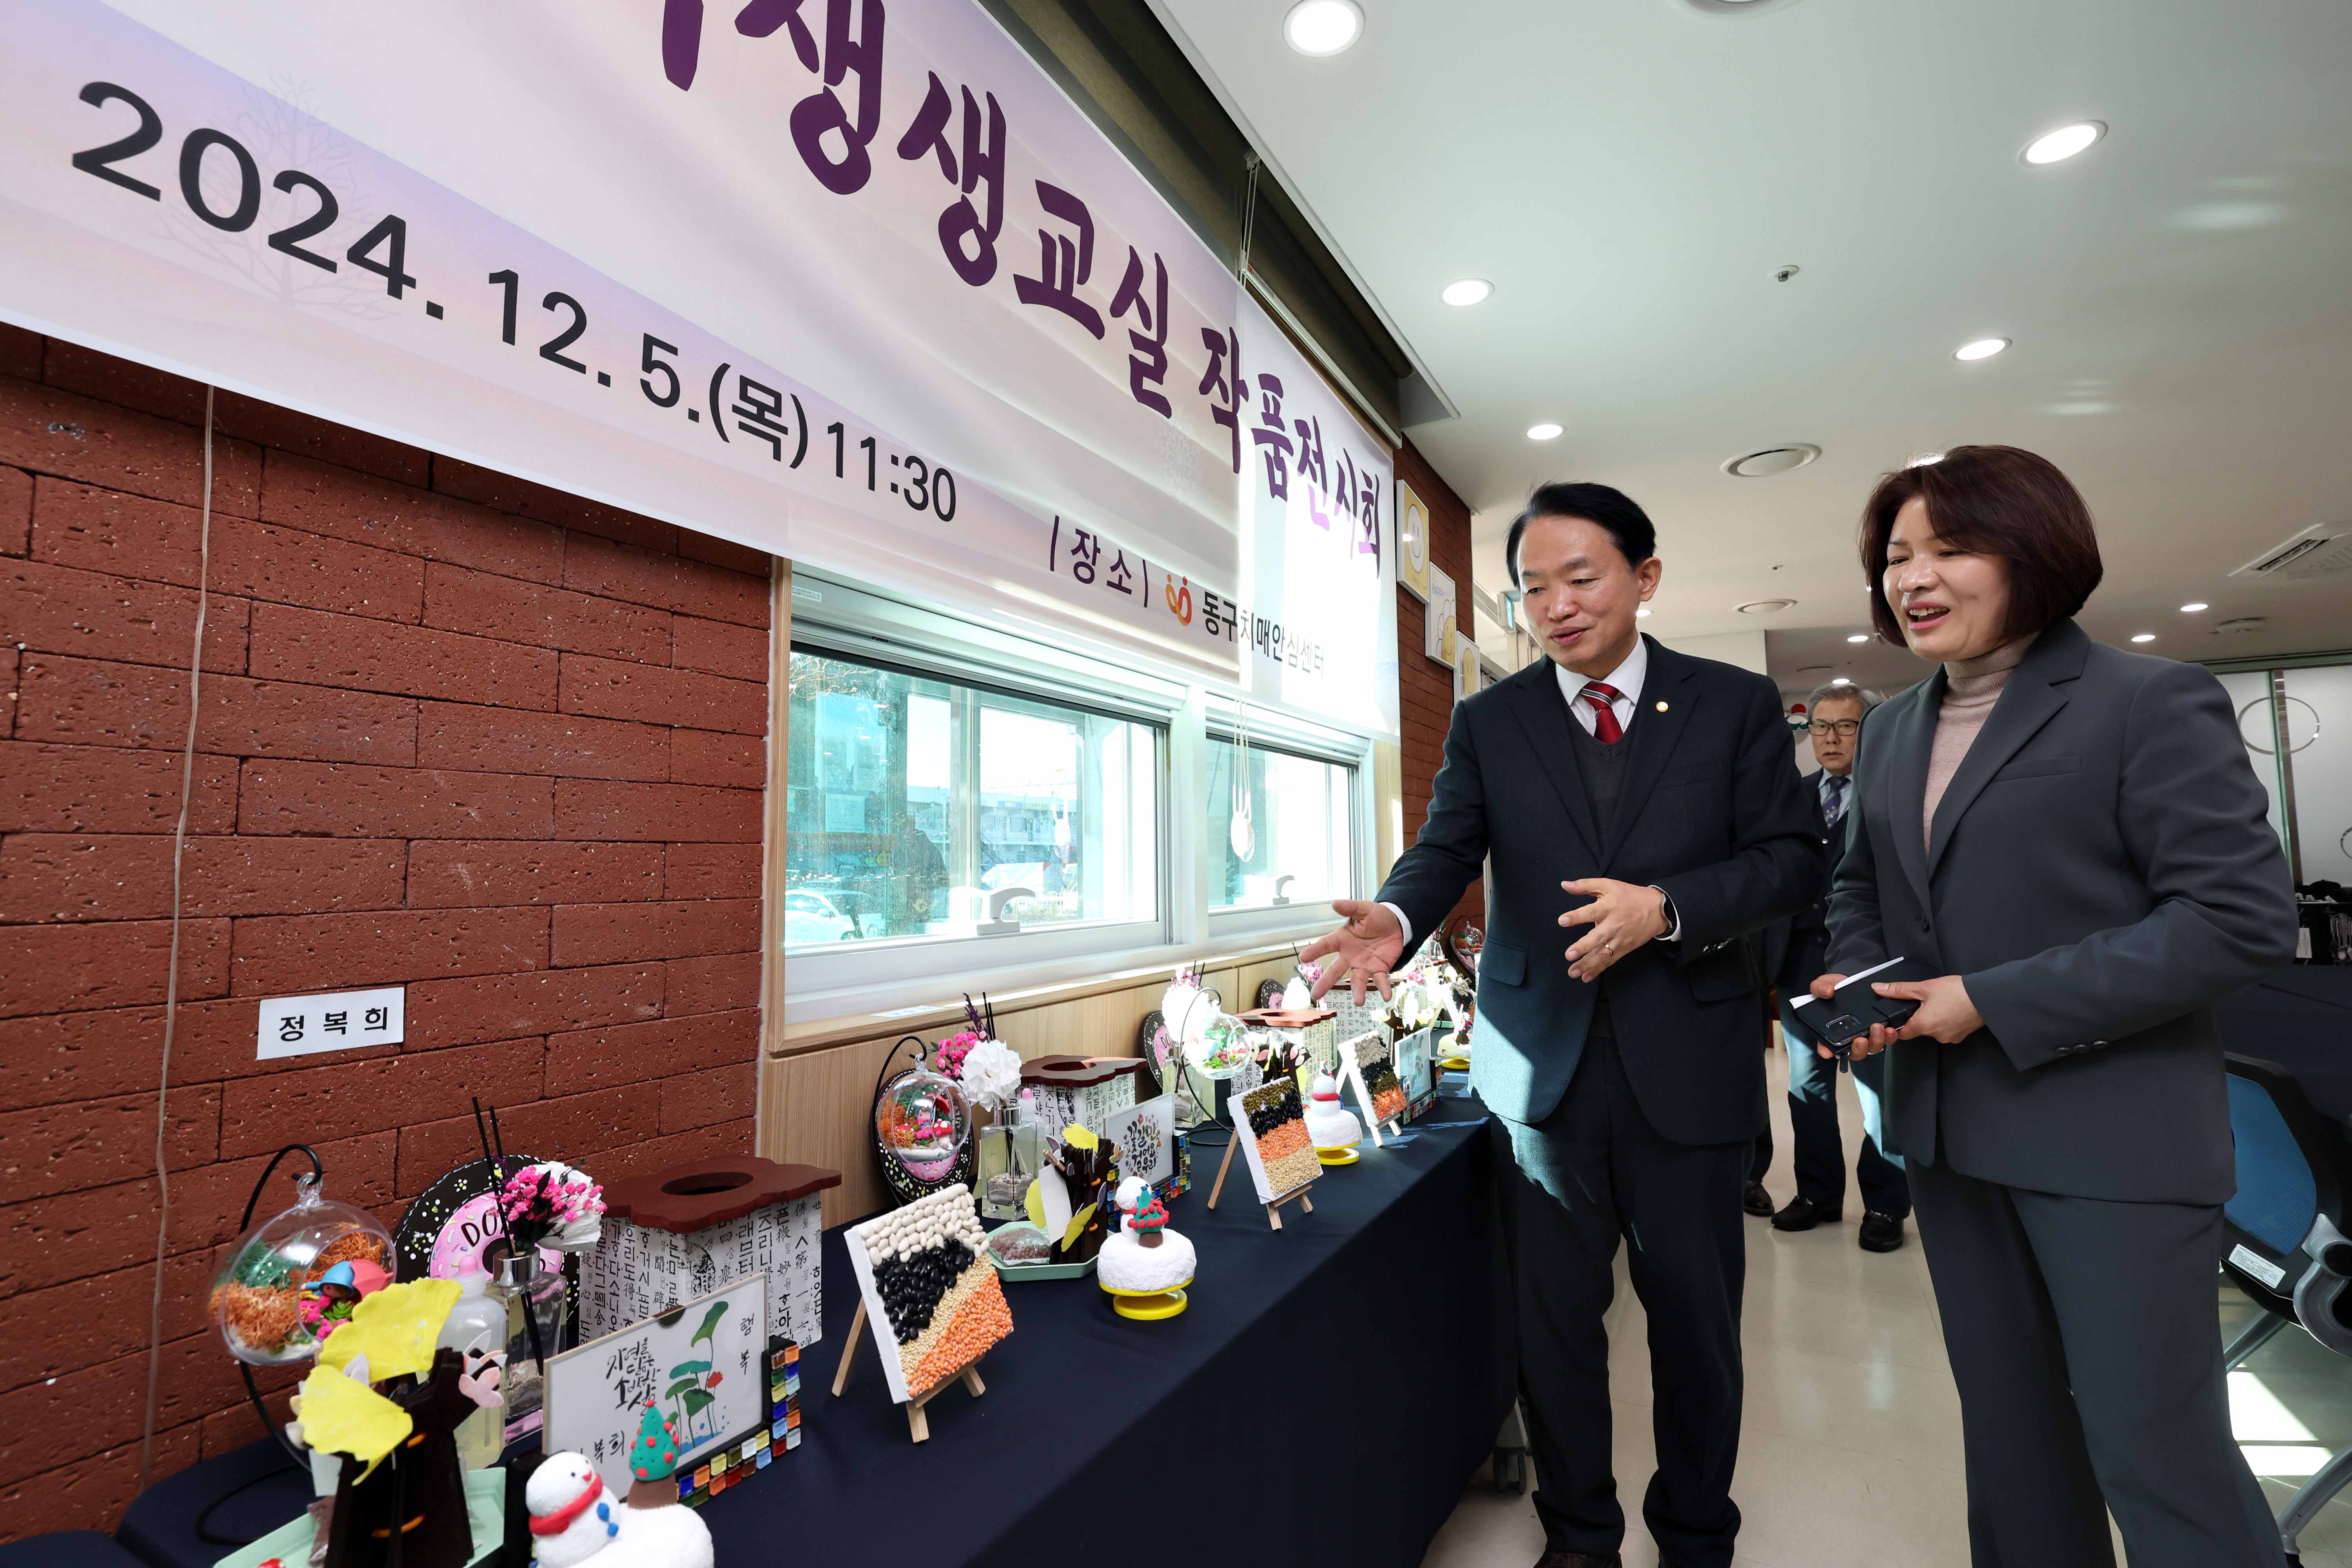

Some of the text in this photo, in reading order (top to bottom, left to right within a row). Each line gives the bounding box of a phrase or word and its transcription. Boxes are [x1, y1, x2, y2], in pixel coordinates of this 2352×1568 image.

[73, 81, 443, 321] 2024.
[827, 422, 958, 523] 11:30
[662, 0, 1380, 580] 생생교실 작품전시회
[1202, 590, 1324, 679] 동구치매안심센터
[581, 1430, 625, 1464] 복희
